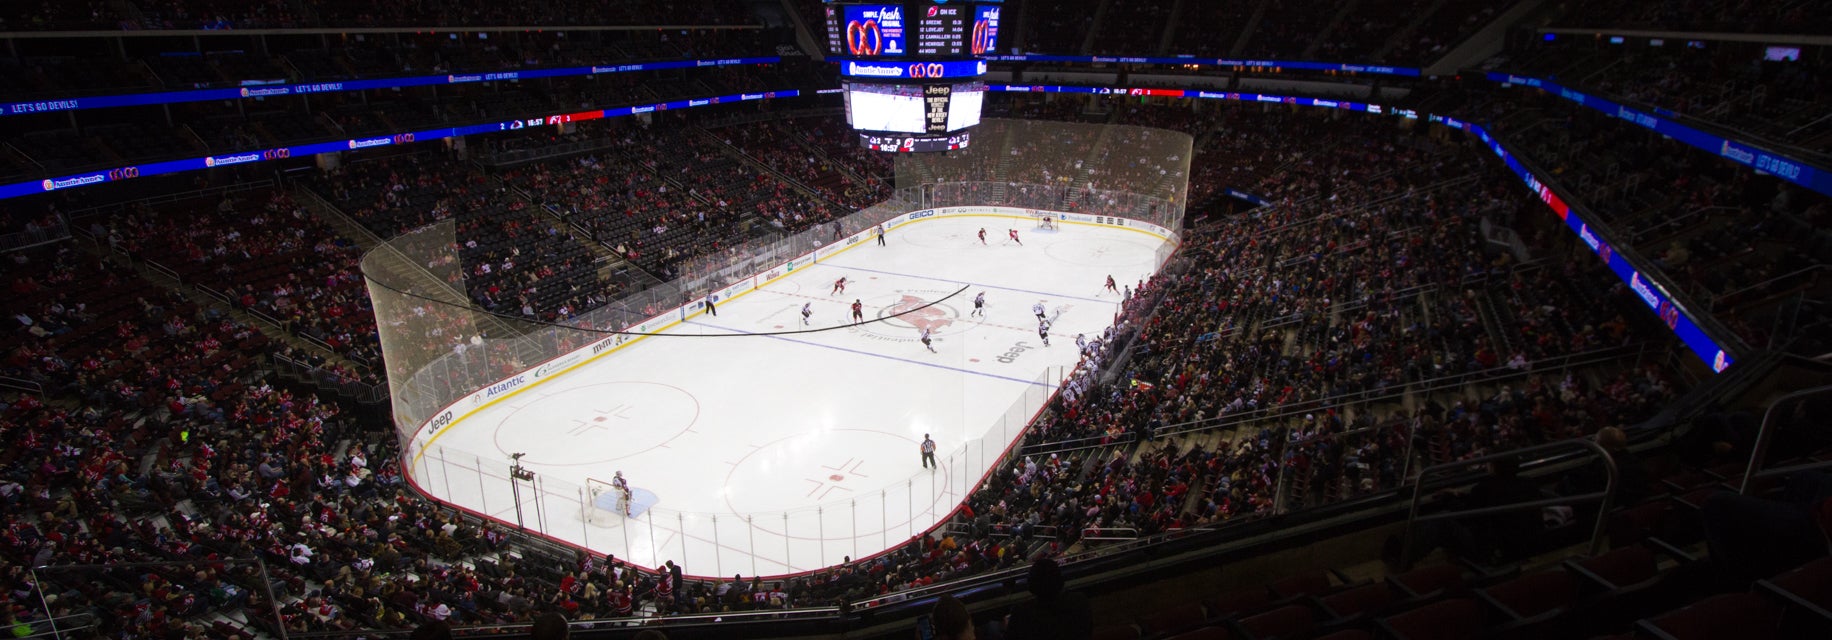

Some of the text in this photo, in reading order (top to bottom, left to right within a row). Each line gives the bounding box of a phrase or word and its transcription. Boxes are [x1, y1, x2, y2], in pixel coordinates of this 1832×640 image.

[878, 7, 901, 23] fresh.
[295, 85, 311, 93] LET'S
[321, 83, 343, 91] DEVILS!
[926, 86, 950, 95] Jeep
[11, 100, 79, 112] LET'S GO DEVILS!
[216, 157, 238, 165] Auntie
[55, 178, 80, 188] Auntie
[909, 210, 934, 220] GEICO
[846, 236, 864, 245] Jeep
[996, 341, 1034, 363] Jeep
[487, 375, 524, 397] Atlantic
[428, 411, 452, 434] Jeep
